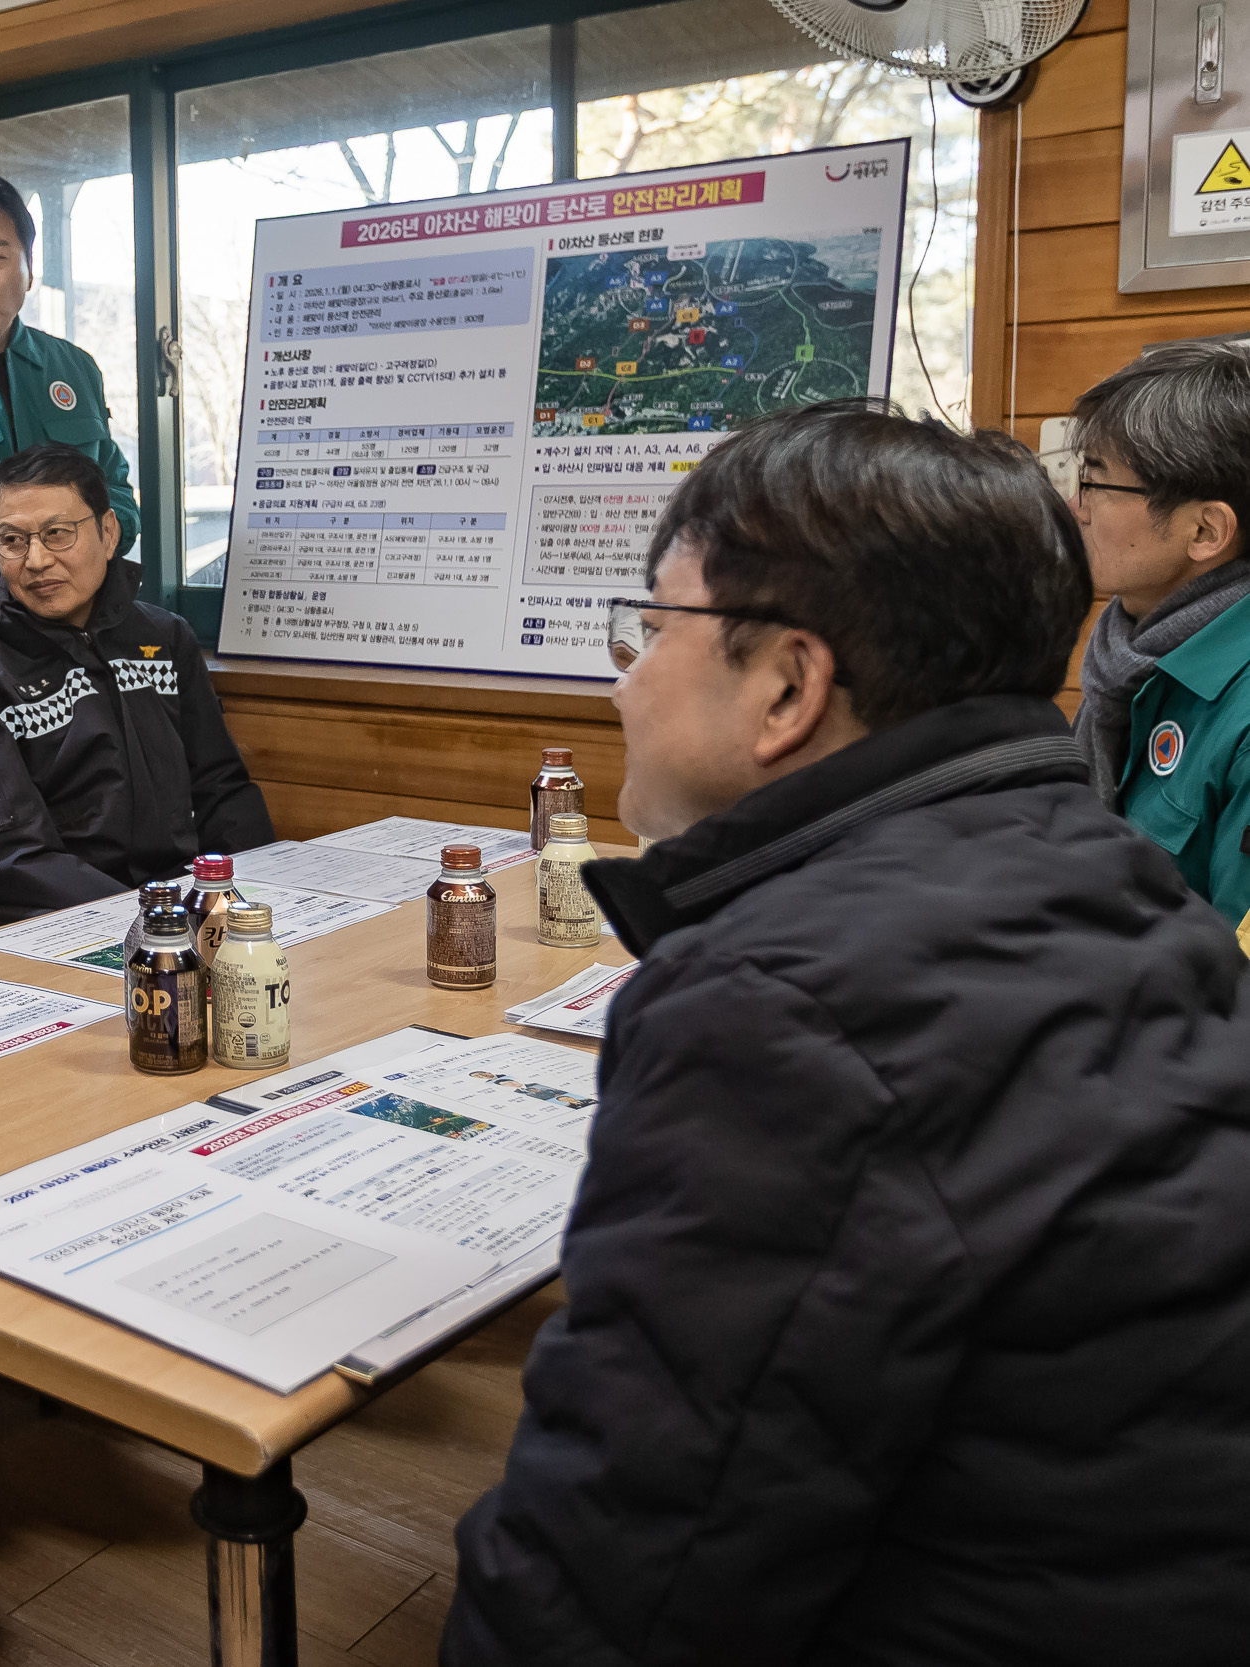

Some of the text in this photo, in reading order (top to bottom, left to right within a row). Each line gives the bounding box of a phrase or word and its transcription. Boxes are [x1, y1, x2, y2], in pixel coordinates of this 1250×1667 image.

[357, 178, 743, 242] 2026년 아차산 해맞이 등산로 안전관리계획
[1200, 198, 1226, 213] 감전
[559, 228, 664, 250] 아차산 등산로 현황
[272, 349, 311, 362] 개선사항
[407, 371, 456, 383] CCTV(15대)
[459, 369, 475, 380] 추가
[479, 368, 495, 379] 설치
[268, 396, 326, 411] 안전관리계획
[266, 416, 295, 426] 안전관리
[543, 446, 571, 457] 계수기
[574, 446, 591, 456] 설치
[595, 445, 613, 456] 지역
[624, 445, 640, 456] A1,
[644, 445, 661, 455] A3,
[665, 444, 681, 455] A4,
[686, 443, 703, 454] A6,
[587, 462, 622, 473] 인파밀집
[626, 462, 643, 472] 대응
[647, 461, 665, 472] 계획
[626, 494, 649, 504] 초과시
[541, 524, 577, 533] 해맞이광장
[579, 524, 600, 533] 900명
[603, 523, 625, 533] 초과시
[540, 538, 630, 547] 일출 이후 하산객 분산 유도
[536, 566, 565, 575] 시간대별
[573, 566, 602, 575] 인파밀집
[527, 596, 592, 608] 인파사고 예방을
[548, 621, 572, 630] 현수막,
[546, 636, 604, 647] 아차산 입구 LED
[441, 889, 487, 903] Cantata
[203, 1129, 250, 1153] 2026년
